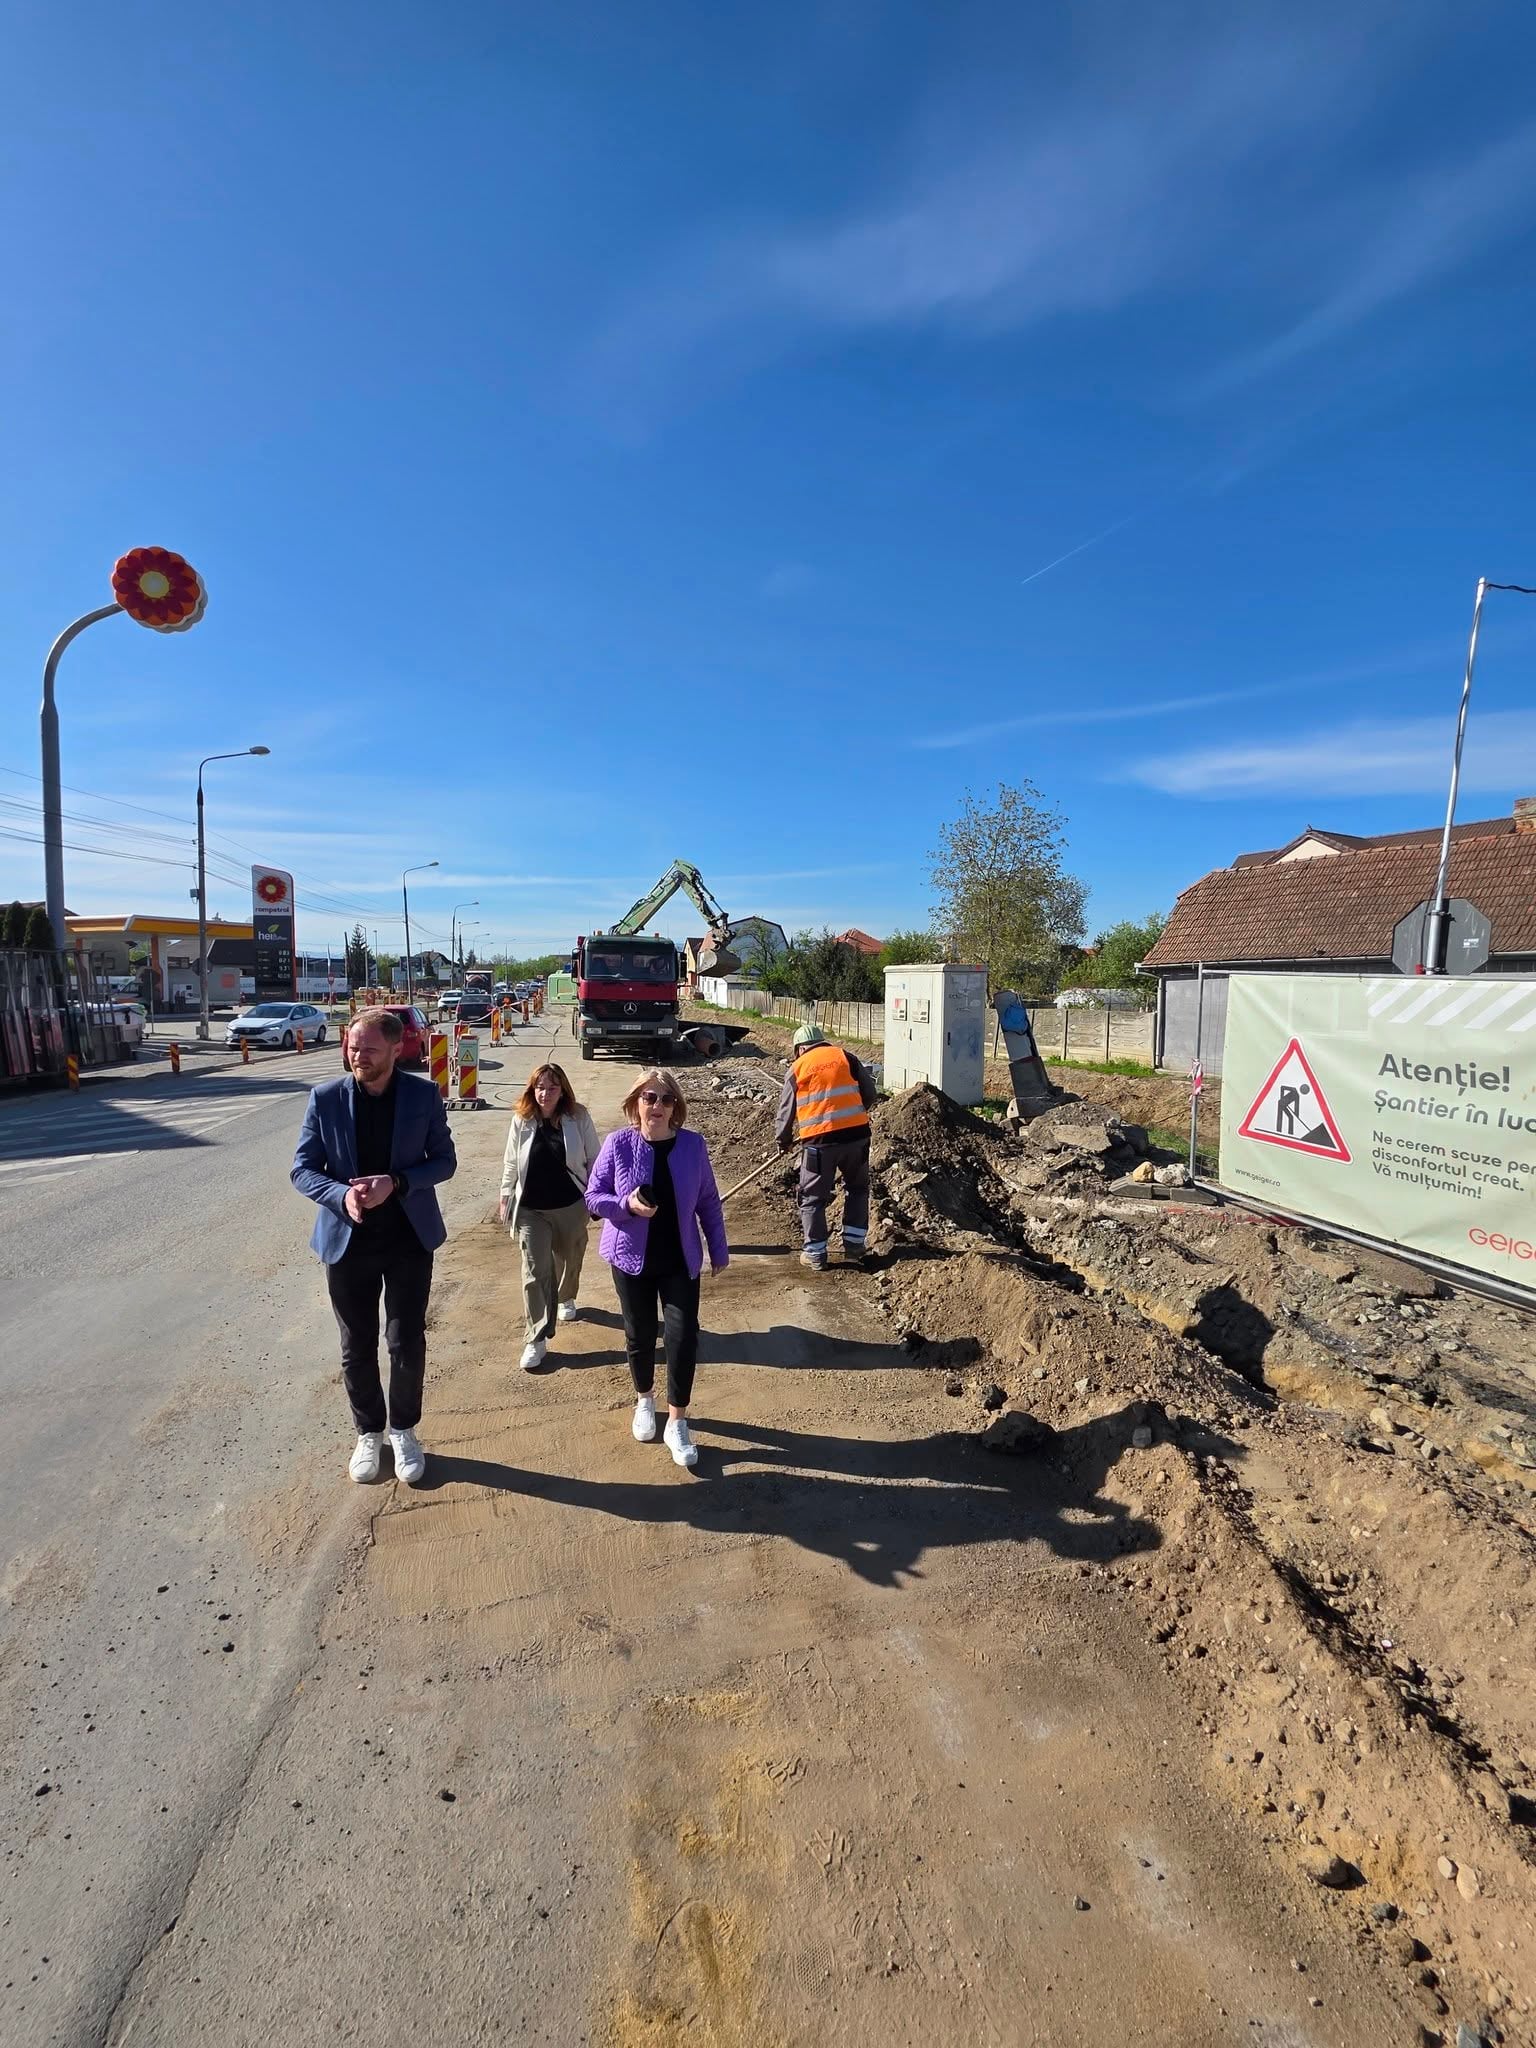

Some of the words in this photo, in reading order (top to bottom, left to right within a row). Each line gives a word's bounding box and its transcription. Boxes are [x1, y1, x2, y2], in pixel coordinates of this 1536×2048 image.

[1378, 1053, 1510, 1096] Atenție!
[1374, 1089, 1459, 1119] Șantier
[1465, 1103, 1489, 1125] în
[1372, 1130, 1392, 1145] Ne
[1396, 1138, 1446, 1156] cerem
[1451, 1149, 1502, 1167] scuze
[1372, 1147, 1467, 1177] disconfortul
[1472, 1171, 1525, 1192] creat.
[1372, 1161, 1391, 1176] Vă
[1395, 1172, 1482, 1199] mulțumim!
